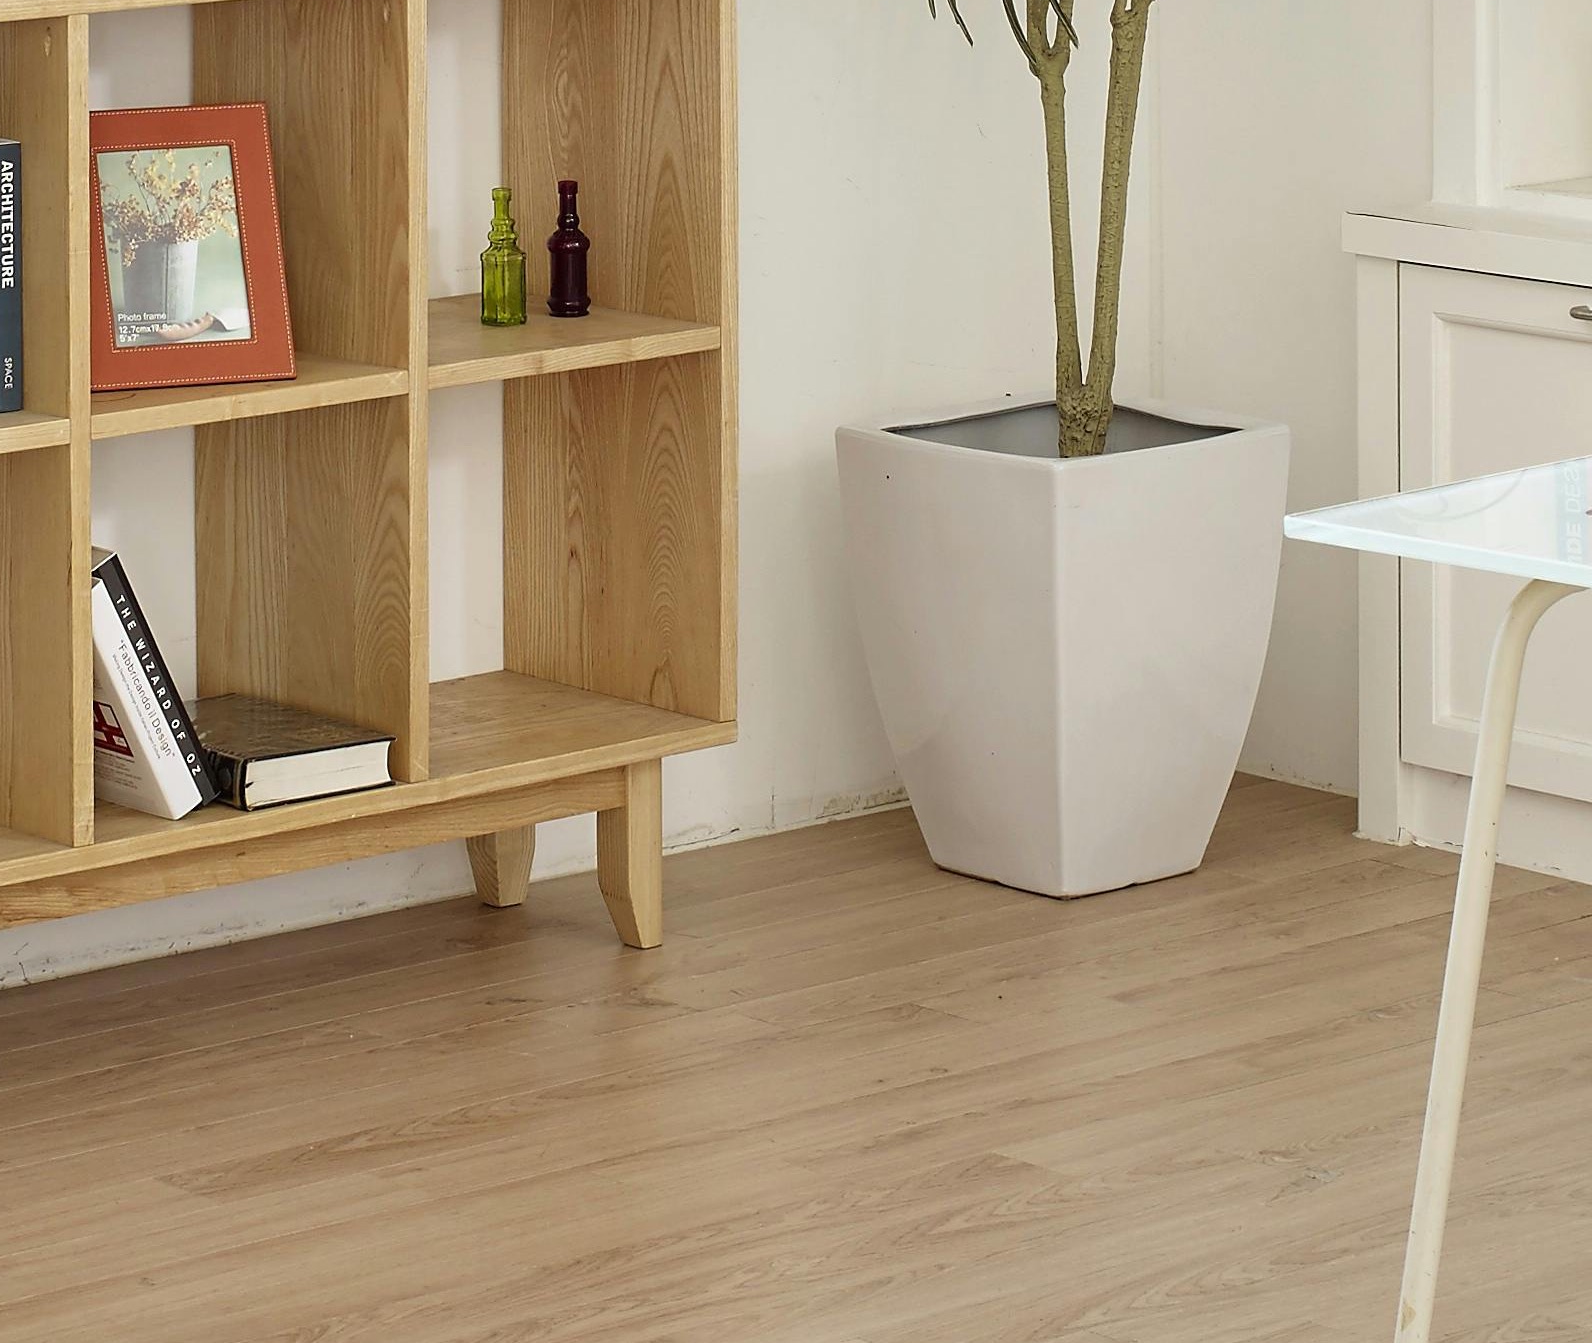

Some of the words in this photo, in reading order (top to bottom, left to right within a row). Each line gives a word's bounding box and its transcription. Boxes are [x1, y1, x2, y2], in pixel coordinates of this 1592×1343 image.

[1, 160, 14, 289] ARCHITECTURE
[118, 313, 142, 322] Photo
[143, 312, 167, 320] frame
[4, 357, 13, 389] SPACE
[116, 594, 136, 631] THE
[135, 638, 172, 710] WIZARD
[171, 718, 186, 742] OF
[186, 753, 202, 777] OZ
